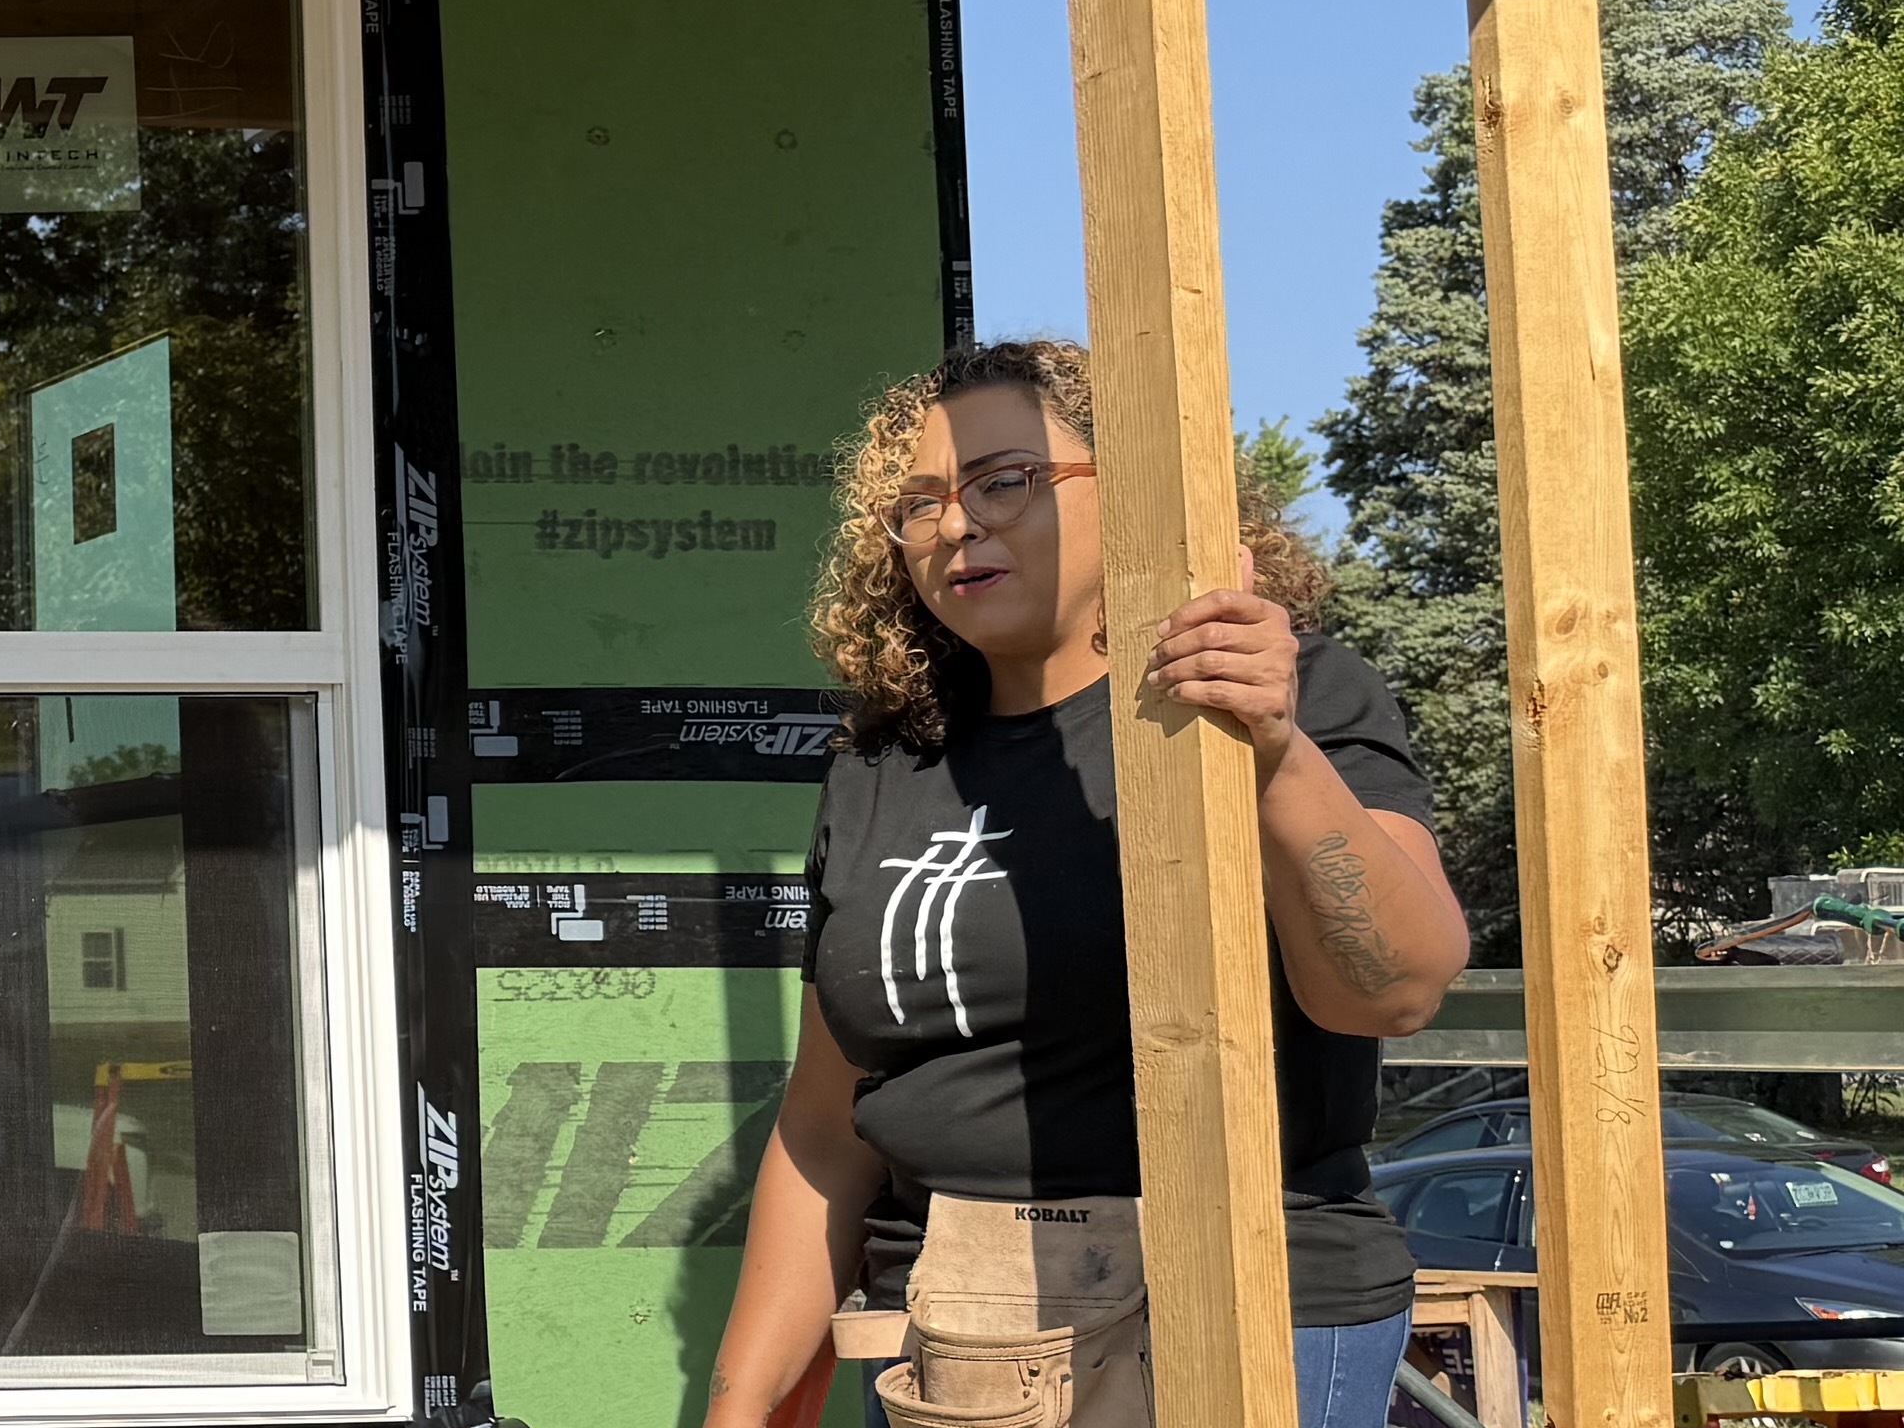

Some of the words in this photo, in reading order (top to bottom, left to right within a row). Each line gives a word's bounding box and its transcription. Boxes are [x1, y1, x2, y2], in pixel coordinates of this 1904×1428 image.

[534, 509, 776, 554] #zipsystem
[639, 700, 683, 715] TAPE
[687, 699, 769, 715] FLASHING
[724, 886, 766, 900] TAPE
[764, 909, 809, 929] em
[411, 1174, 426, 1263] FLASHING
[1014, 1206, 1090, 1223] KOBALT
[412, 1266, 427, 1313] TAPE
